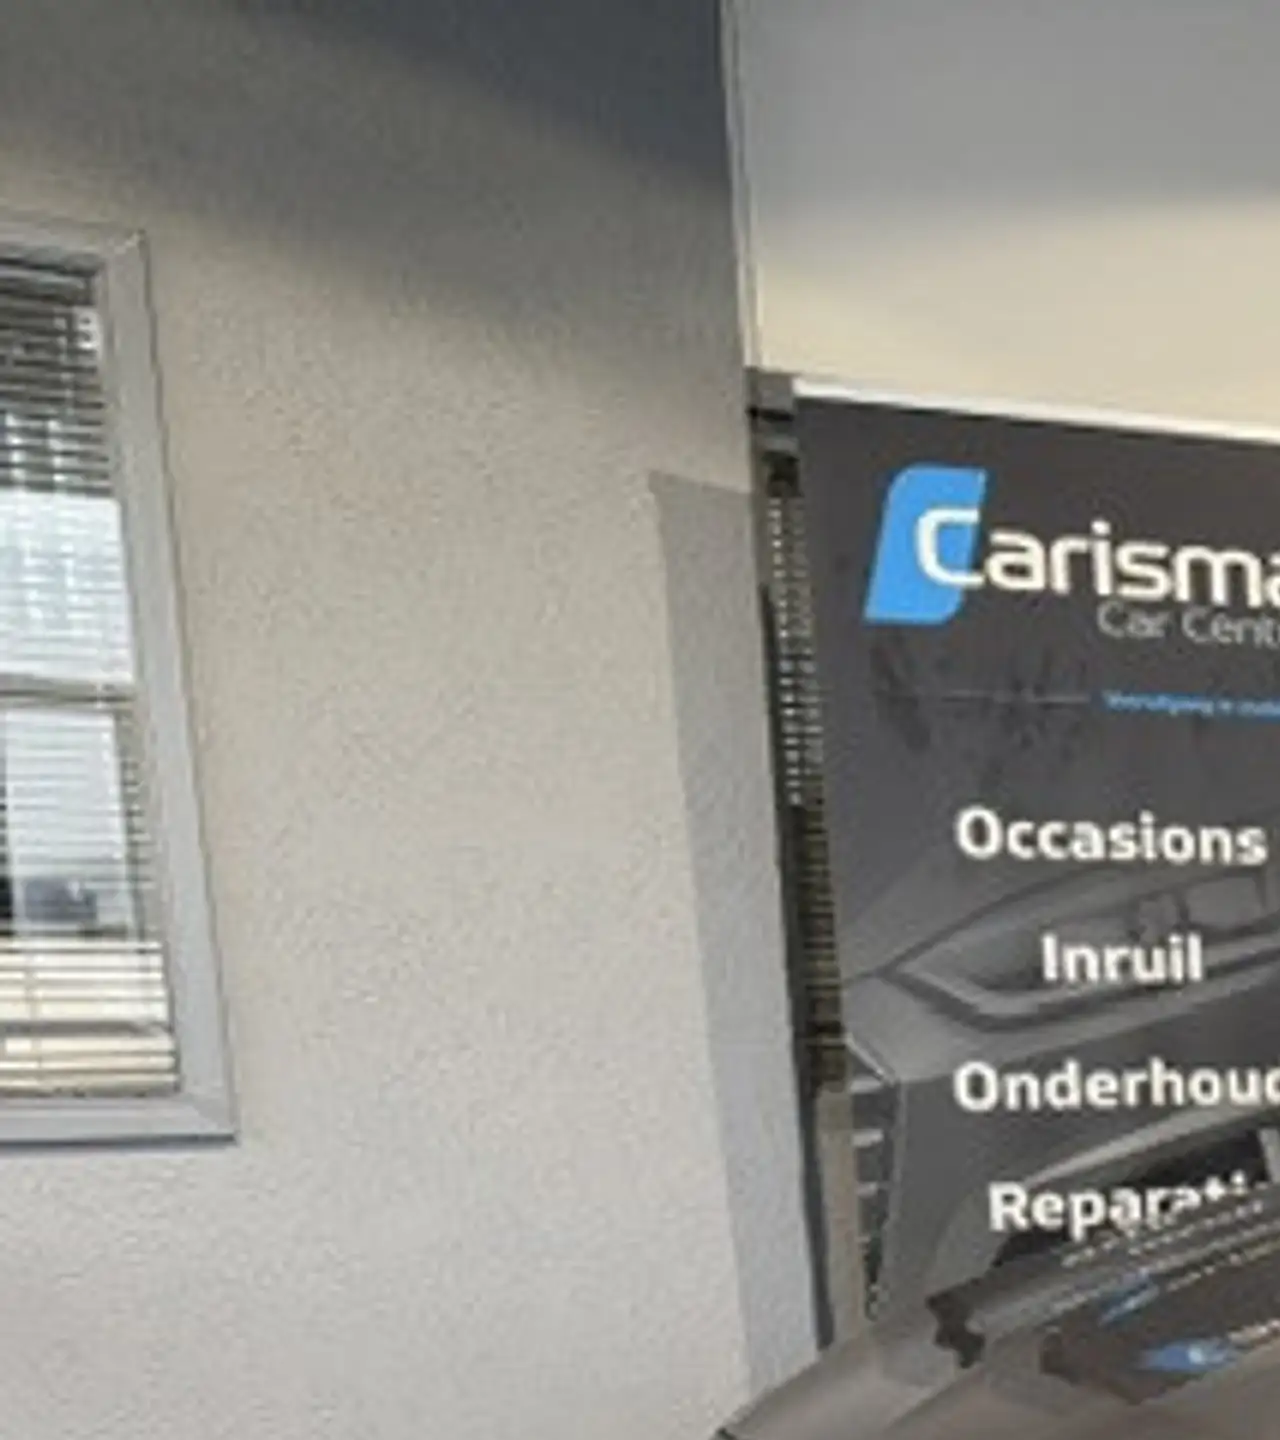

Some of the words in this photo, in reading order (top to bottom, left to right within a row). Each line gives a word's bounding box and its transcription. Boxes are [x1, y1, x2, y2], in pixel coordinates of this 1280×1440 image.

[1096, 600, 1170, 639] Car
[954, 804, 1269, 866] Occasions
[1041, 933, 1204, 983] Inruil
